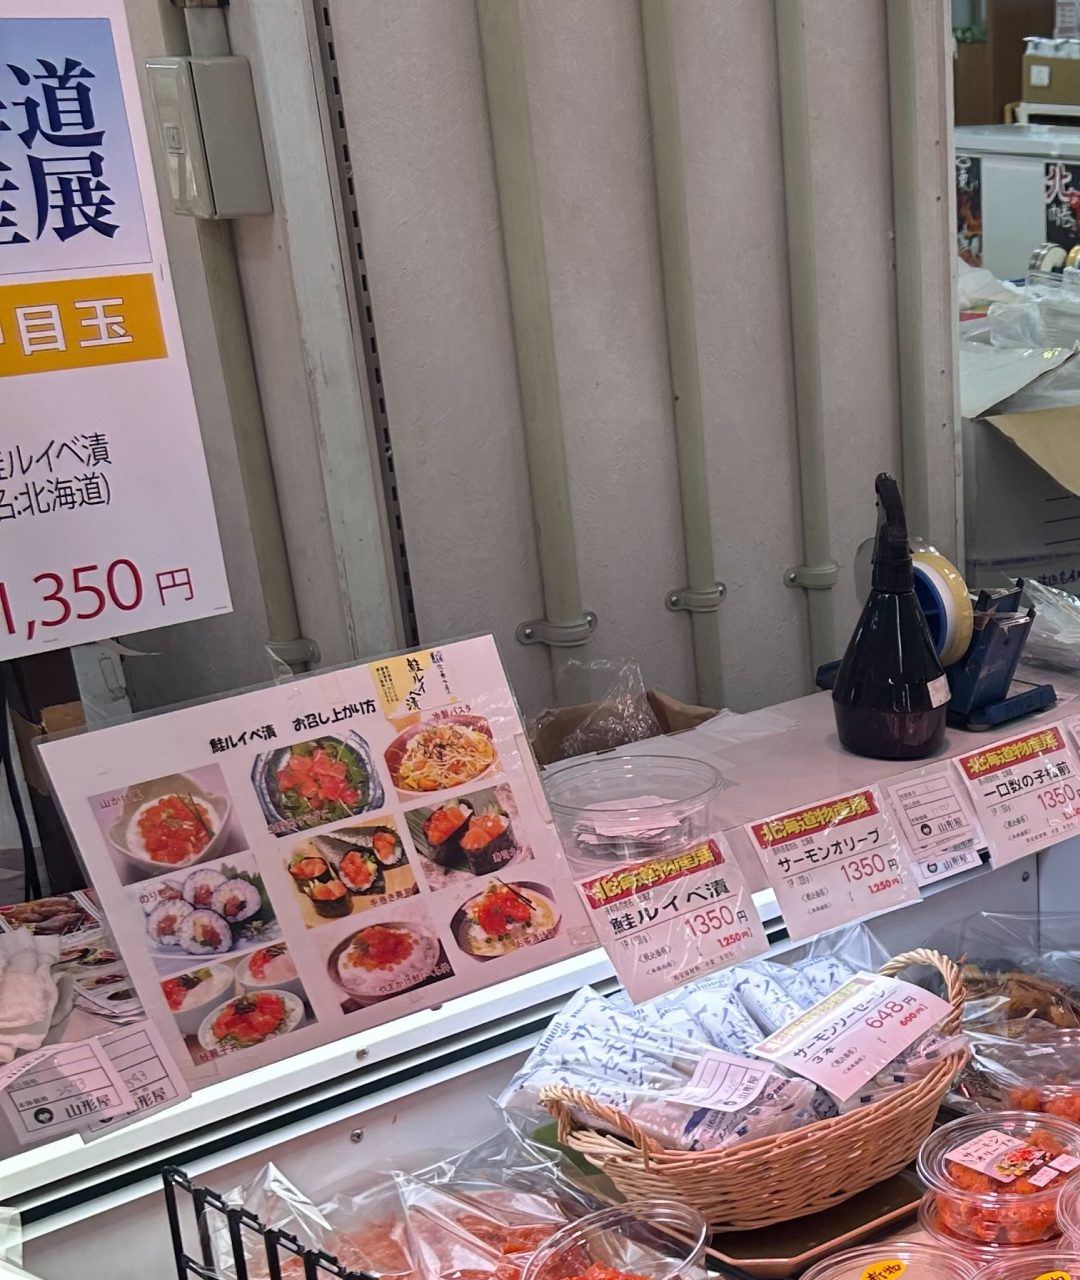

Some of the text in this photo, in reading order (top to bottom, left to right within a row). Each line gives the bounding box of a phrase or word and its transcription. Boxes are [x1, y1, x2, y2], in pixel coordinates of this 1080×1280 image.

[0, 57, 105, 150] 道
[0, 153, 120, 245] 展
[0, 297, 133, 357] 目玉
[209, 699, 376, 755] 鮭ルイベ漬 お召し上がり方
[777, 827, 880, 873] サーモンオリーブ
[608, 877, 731, 935] 鮭ルイベ漬
[65, 1094, 111, 1119] 山形屋
